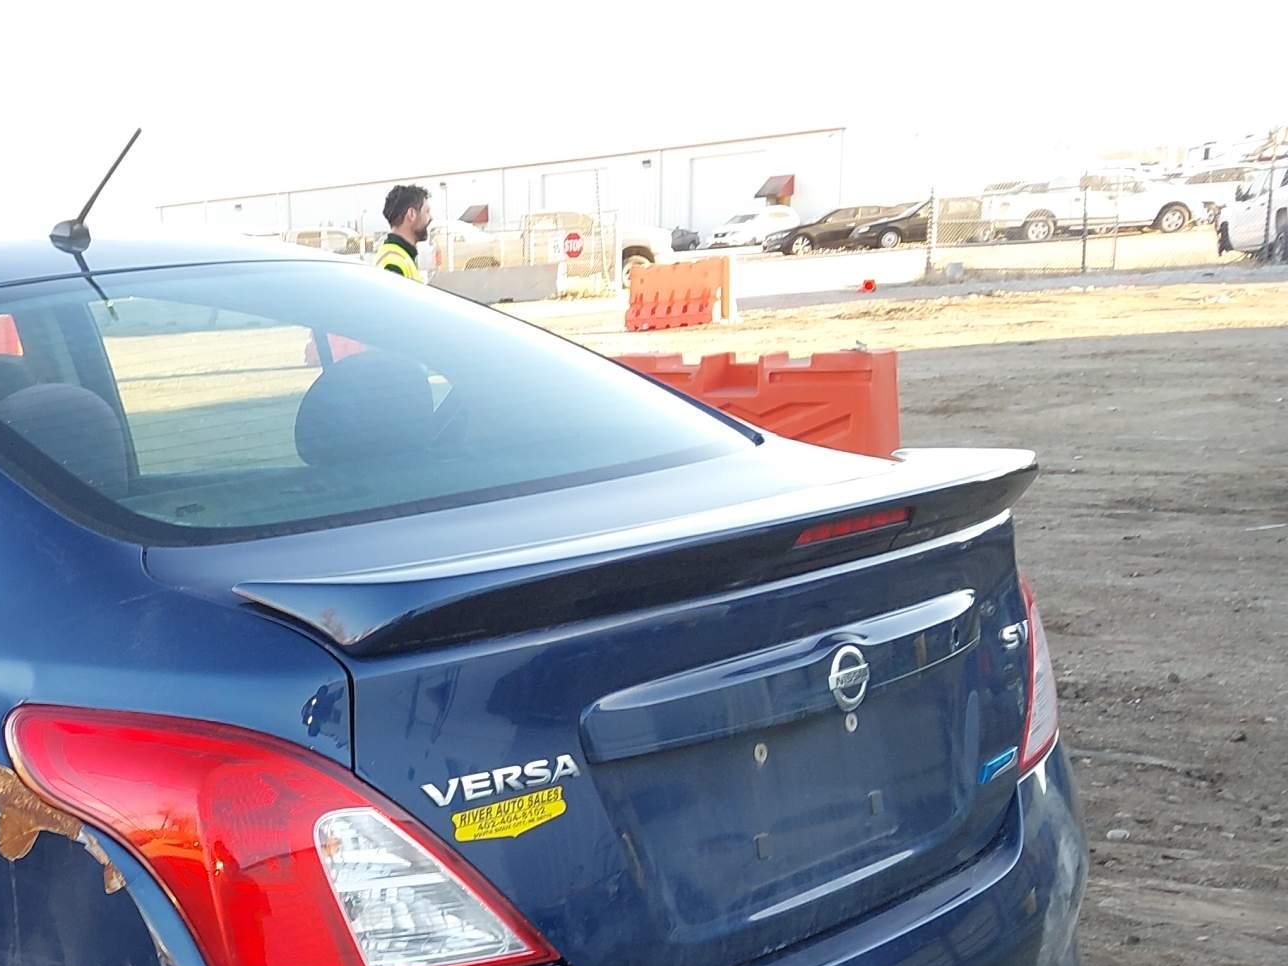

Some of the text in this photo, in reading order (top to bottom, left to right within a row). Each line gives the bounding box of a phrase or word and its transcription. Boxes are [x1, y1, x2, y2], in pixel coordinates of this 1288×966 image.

[563, 239, 583, 252] STOP
[420, 754, 581, 807] VERSA
[459, 806, 493, 827] RIVER
[496, 798, 524, 817] AUTO
[527, 788, 559, 808] SALES
